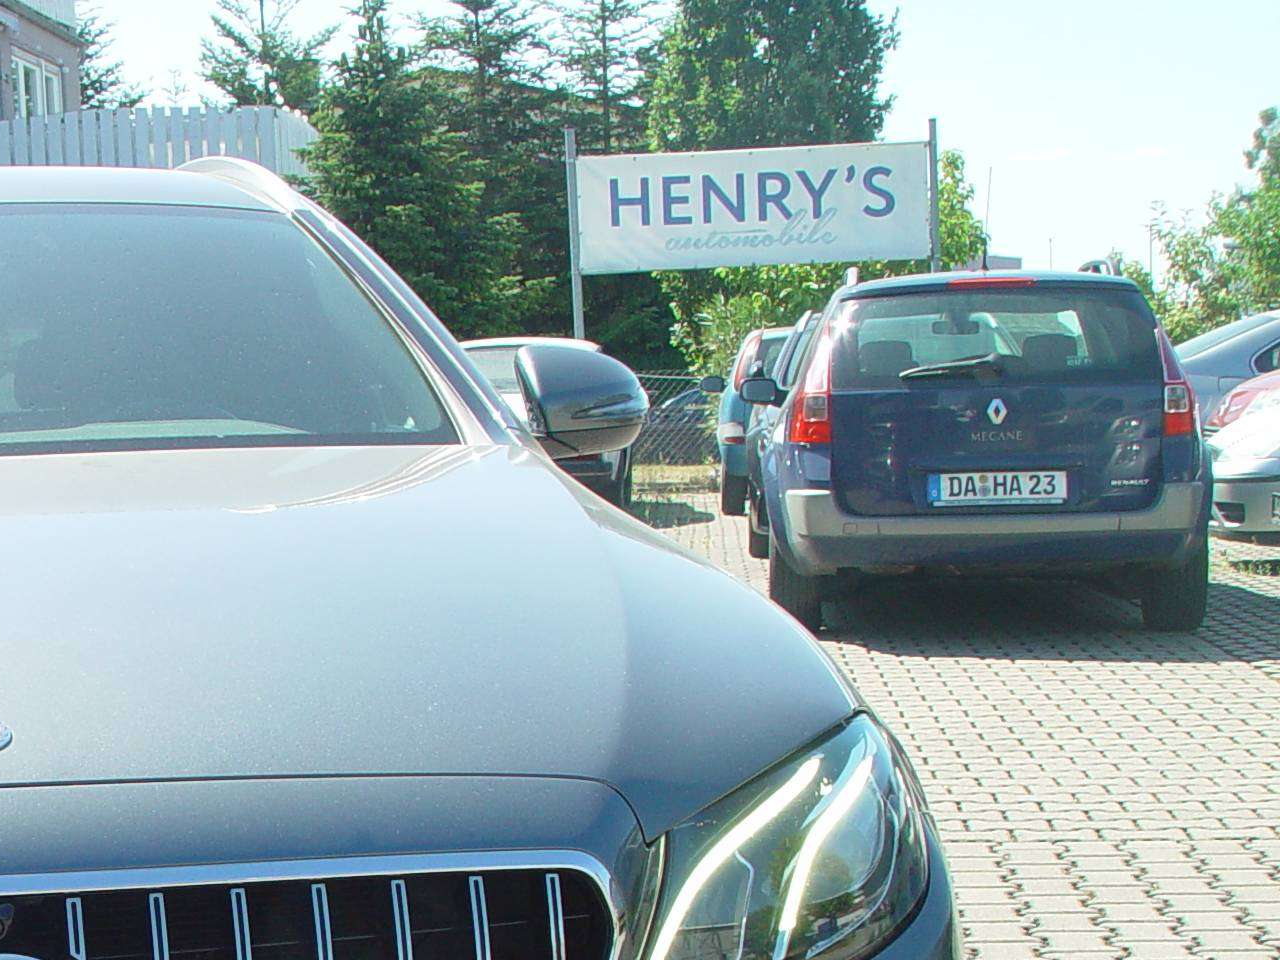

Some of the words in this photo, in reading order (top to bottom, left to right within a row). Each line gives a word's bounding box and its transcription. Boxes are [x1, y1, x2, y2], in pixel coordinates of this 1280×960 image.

[609, 164, 896, 227] HENRY'S
[664, 207, 839, 252] automobile
[948, 476, 977, 498] DA
[993, 475, 1022, 496] HA
[1029, 474, 1056, 495] 23
